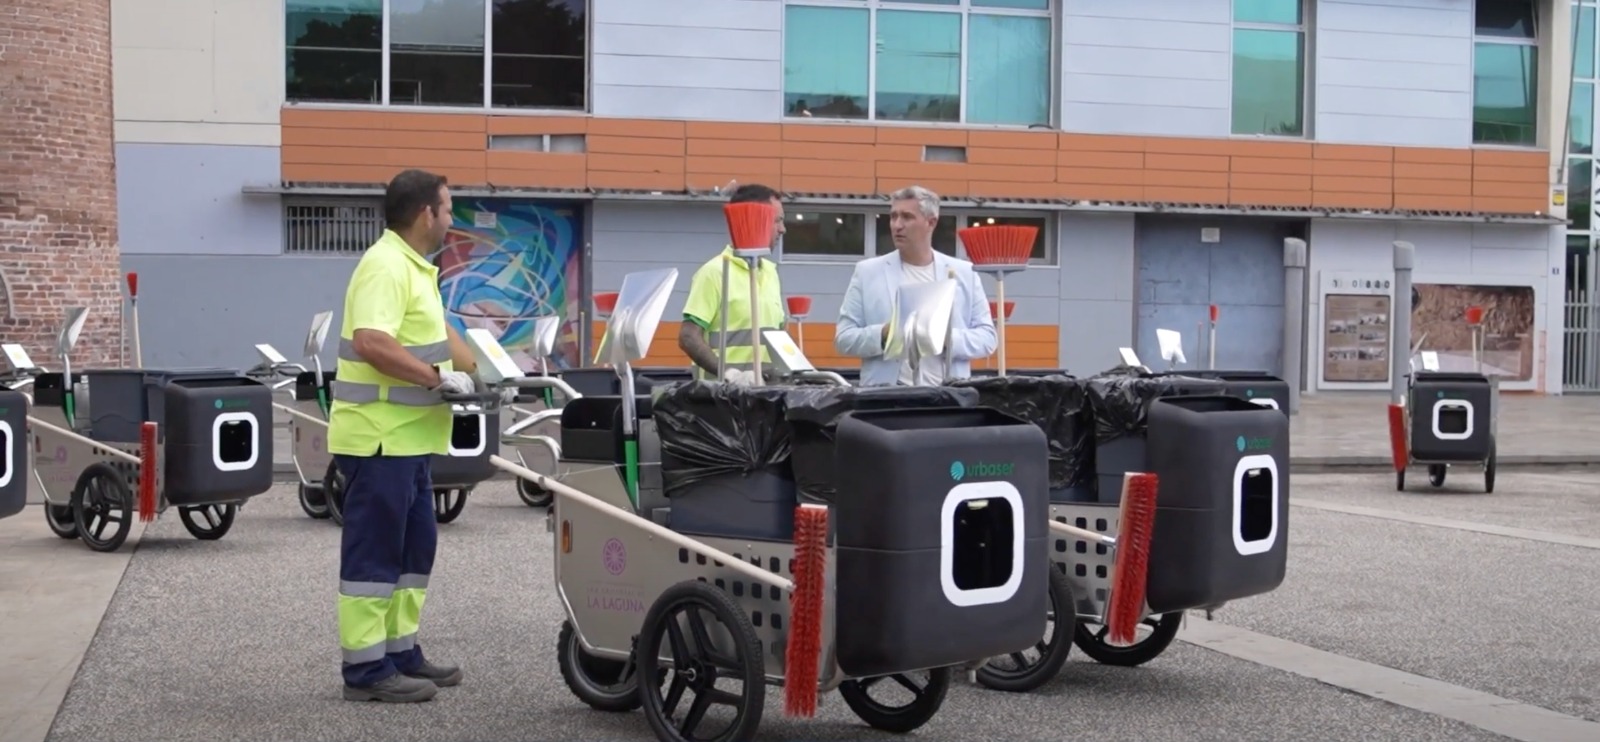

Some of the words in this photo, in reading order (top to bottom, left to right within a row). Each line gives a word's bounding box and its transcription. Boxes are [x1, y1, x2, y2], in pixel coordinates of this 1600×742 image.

[967, 461, 1015, 477] urbaser
[587, 595, 600, 609] LA
[602, 597, 646, 613] LAGUNA
